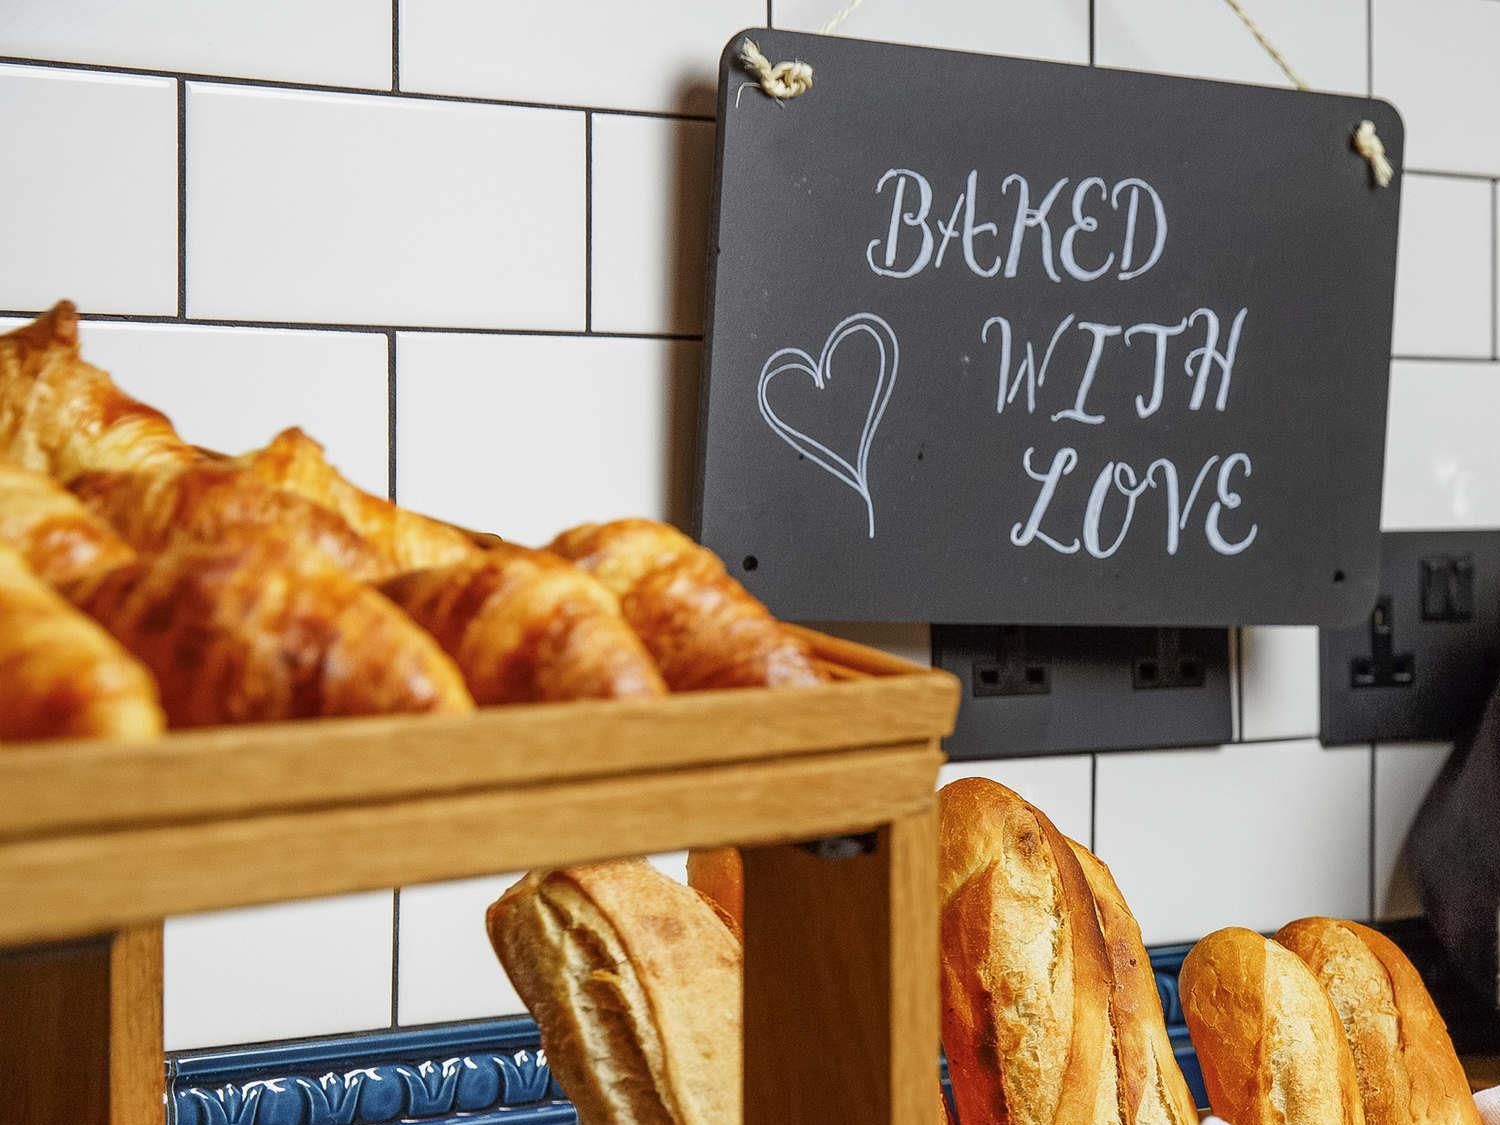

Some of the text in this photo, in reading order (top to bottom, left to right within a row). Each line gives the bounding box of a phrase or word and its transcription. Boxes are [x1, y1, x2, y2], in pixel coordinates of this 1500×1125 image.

[866, 167, 1168, 283] BAKED
[981, 306, 1248, 425] WITH
[1009, 446, 1258, 559] LOVE
